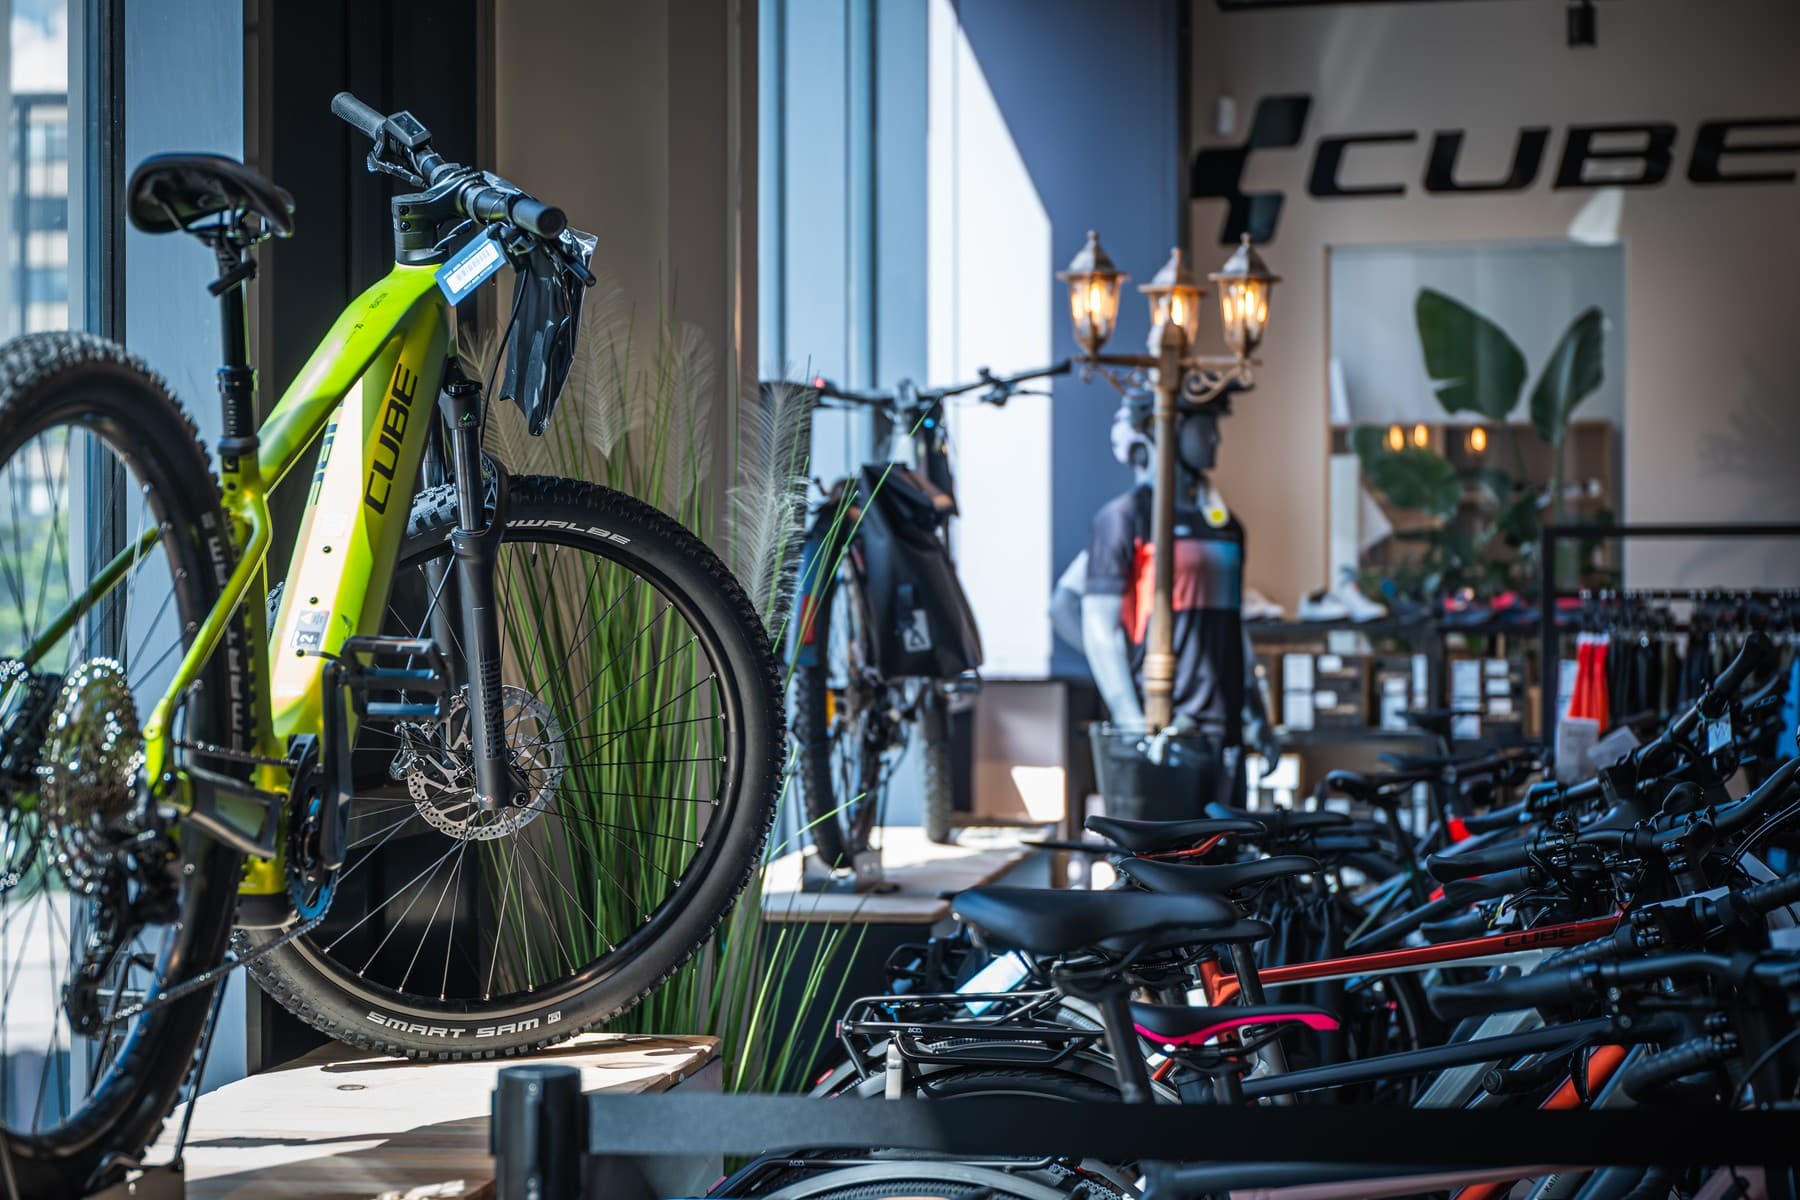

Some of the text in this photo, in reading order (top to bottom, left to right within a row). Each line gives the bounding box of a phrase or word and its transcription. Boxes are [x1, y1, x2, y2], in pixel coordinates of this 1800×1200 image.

[1306, 115, 1800, 197] CUBE
[365, 363, 418, 515] CUBE
[506, 519, 631, 545] WALBE
[1504, 928, 1576, 947] CUBE
[366, 1011, 540, 1038] SMART SAM
